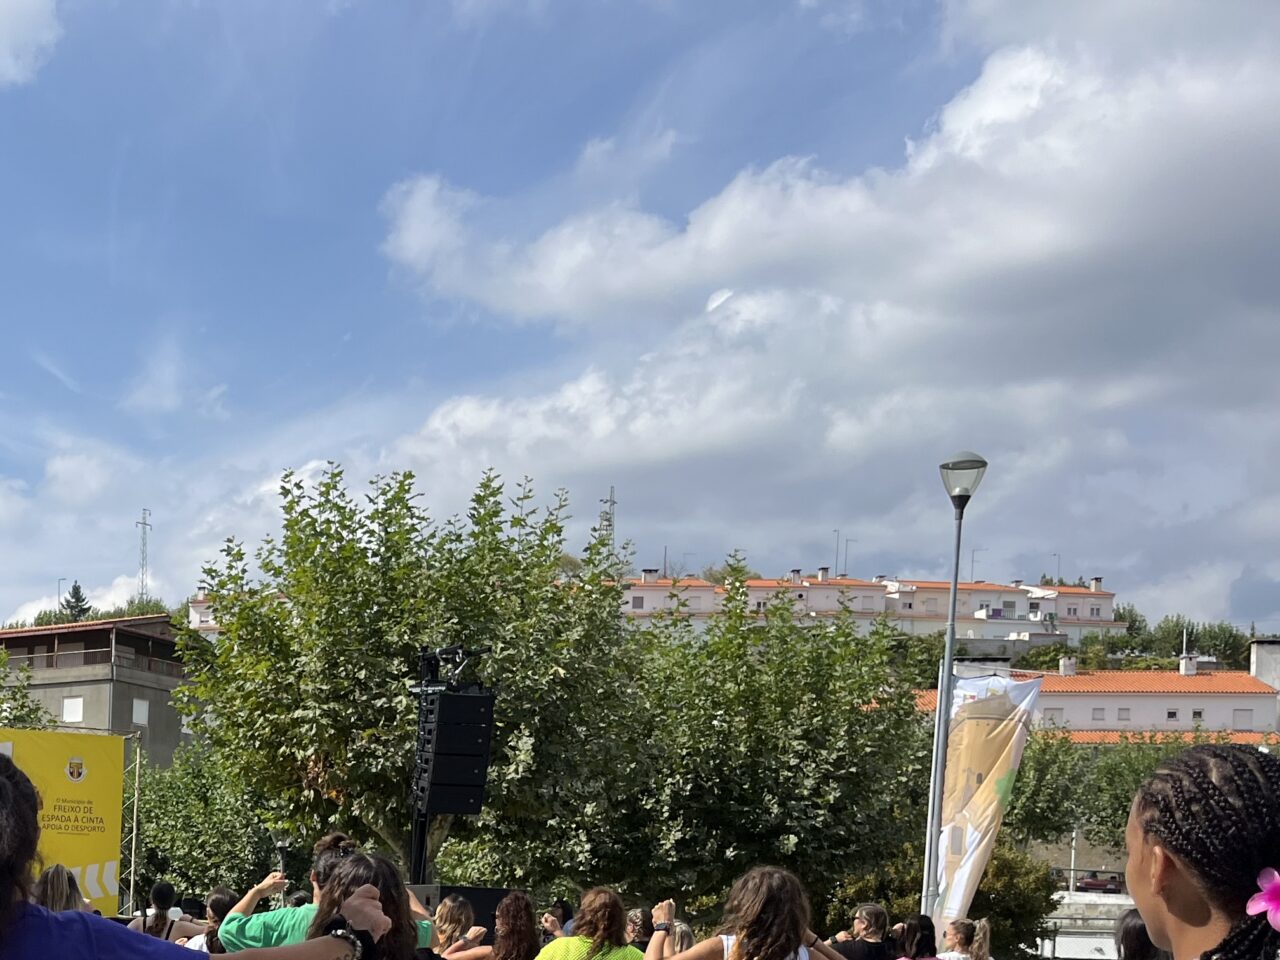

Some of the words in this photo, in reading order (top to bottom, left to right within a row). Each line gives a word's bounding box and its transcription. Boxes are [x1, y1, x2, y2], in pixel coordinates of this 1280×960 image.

[53, 804, 81, 813] FREIXO
[83, 806, 94, 815] DE
[41, 814, 71, 823] ESPADA
[81, 816, 105, 825] CINTA
[42, 823, 62, 831] APOIA
[71, 825, 106, 833] DESPORTO
